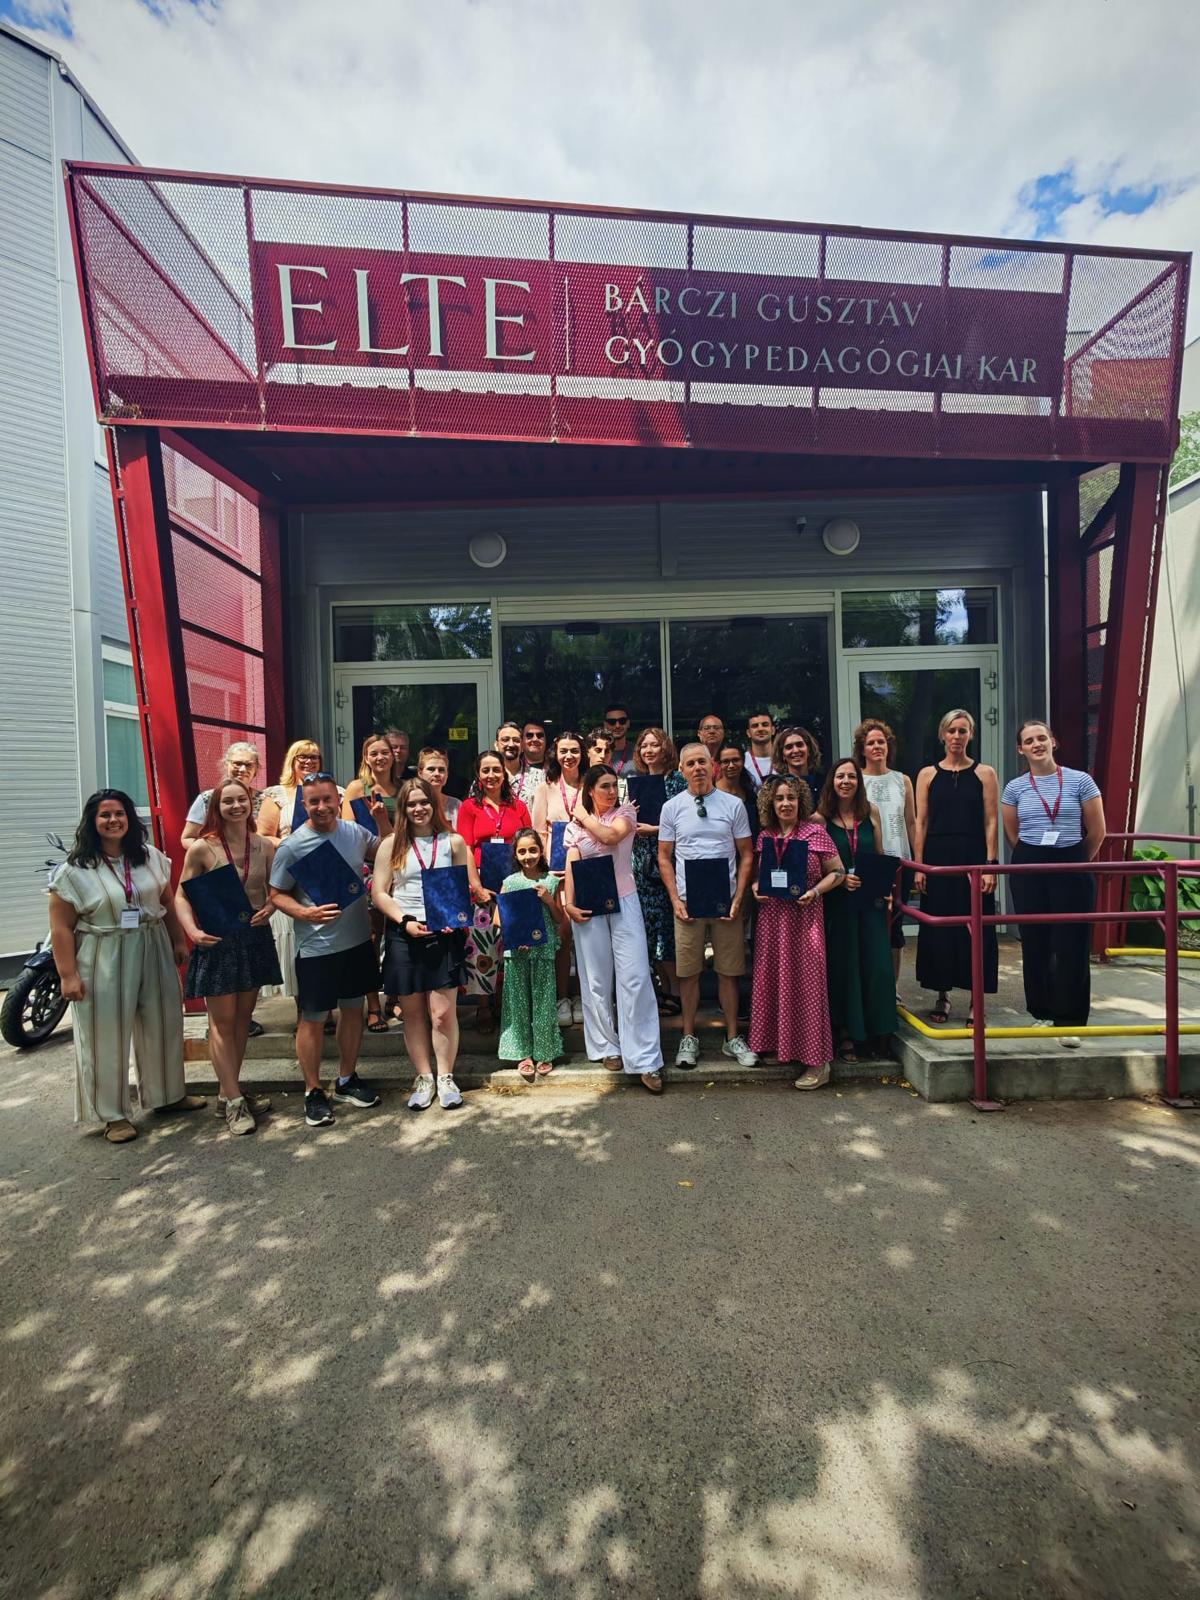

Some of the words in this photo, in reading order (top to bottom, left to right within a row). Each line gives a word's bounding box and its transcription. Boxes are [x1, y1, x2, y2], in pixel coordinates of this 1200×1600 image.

[275, 263, 536, 362] ELTE
[604, 276, 737, 318] BÁRCZI
[756, 292, 923, 327] GUSZTÁV
[604, 328, 962, 379] GYÓGYPEDAGÓGIAI
[979, 355, 1038, 383] KAR
